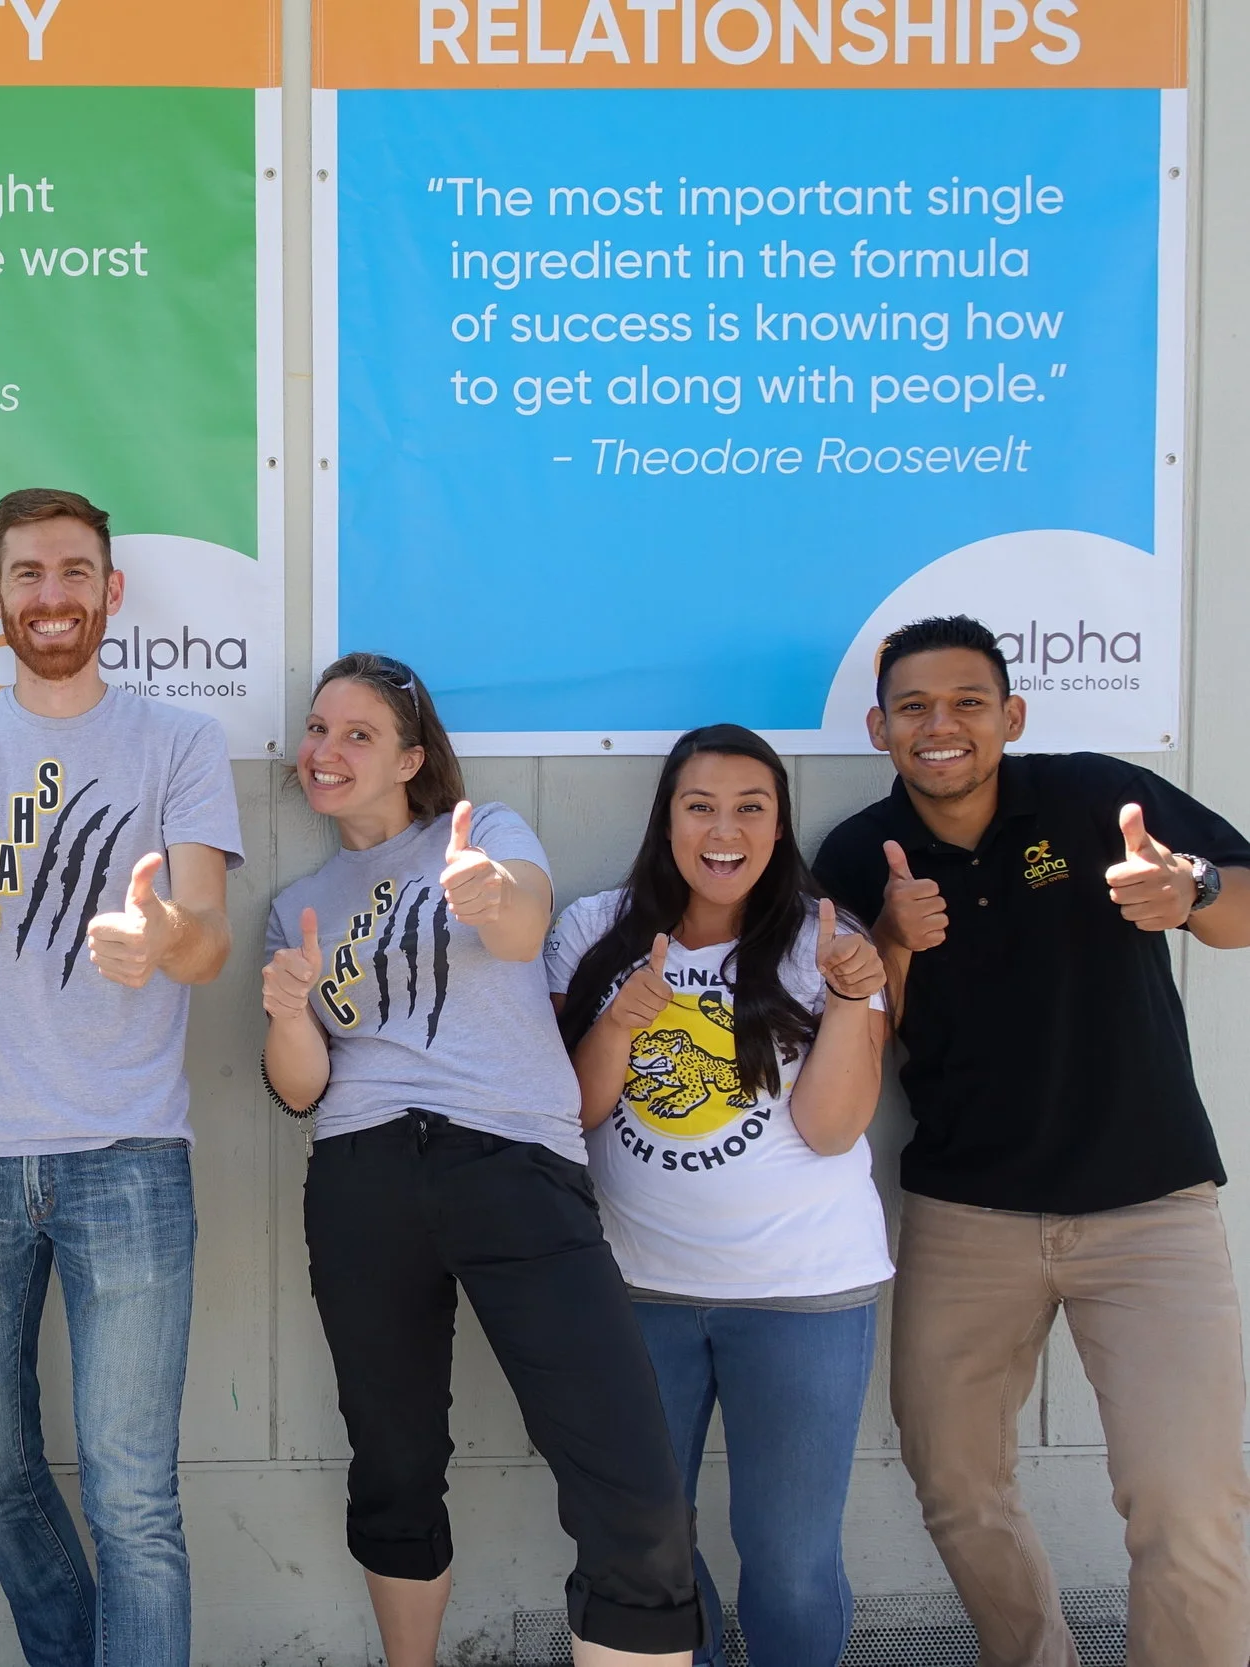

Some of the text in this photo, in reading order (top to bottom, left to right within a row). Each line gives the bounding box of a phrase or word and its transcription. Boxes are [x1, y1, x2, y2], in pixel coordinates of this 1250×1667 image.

[419, 0, 1082, 65] RELATIONSHIPS
[549, 182, 664, 217] most
[679, 177, 913, 225] important
[928, 176, 1065, 225] single
[21, 241, 149, 278] worst
[452, 238, 1029, 290] ingredient in the formula
[451, 303, 1064, 351] of success is knowing how
[451, 371, 499, 405] to
[513, 370, 593, 416] get
[607, 366, 742, 415] along
[758, 366, 855, 404] with
[591, 439, 803, 476] Theodore
[816, 435, 1033, 474] Roosevelt
[98, 625, 247, 682] alpha
[995, 619, 1141, 676] alpha
[166, 681, 247, 697] schools
[1009, 674, 1141, 692] ublic schools
[1024, 858, 1068, 880] alpha
[319, 878, 394, 1027] CAHS
[612, 1097, 772, 1172] HIGH SCHOOL
